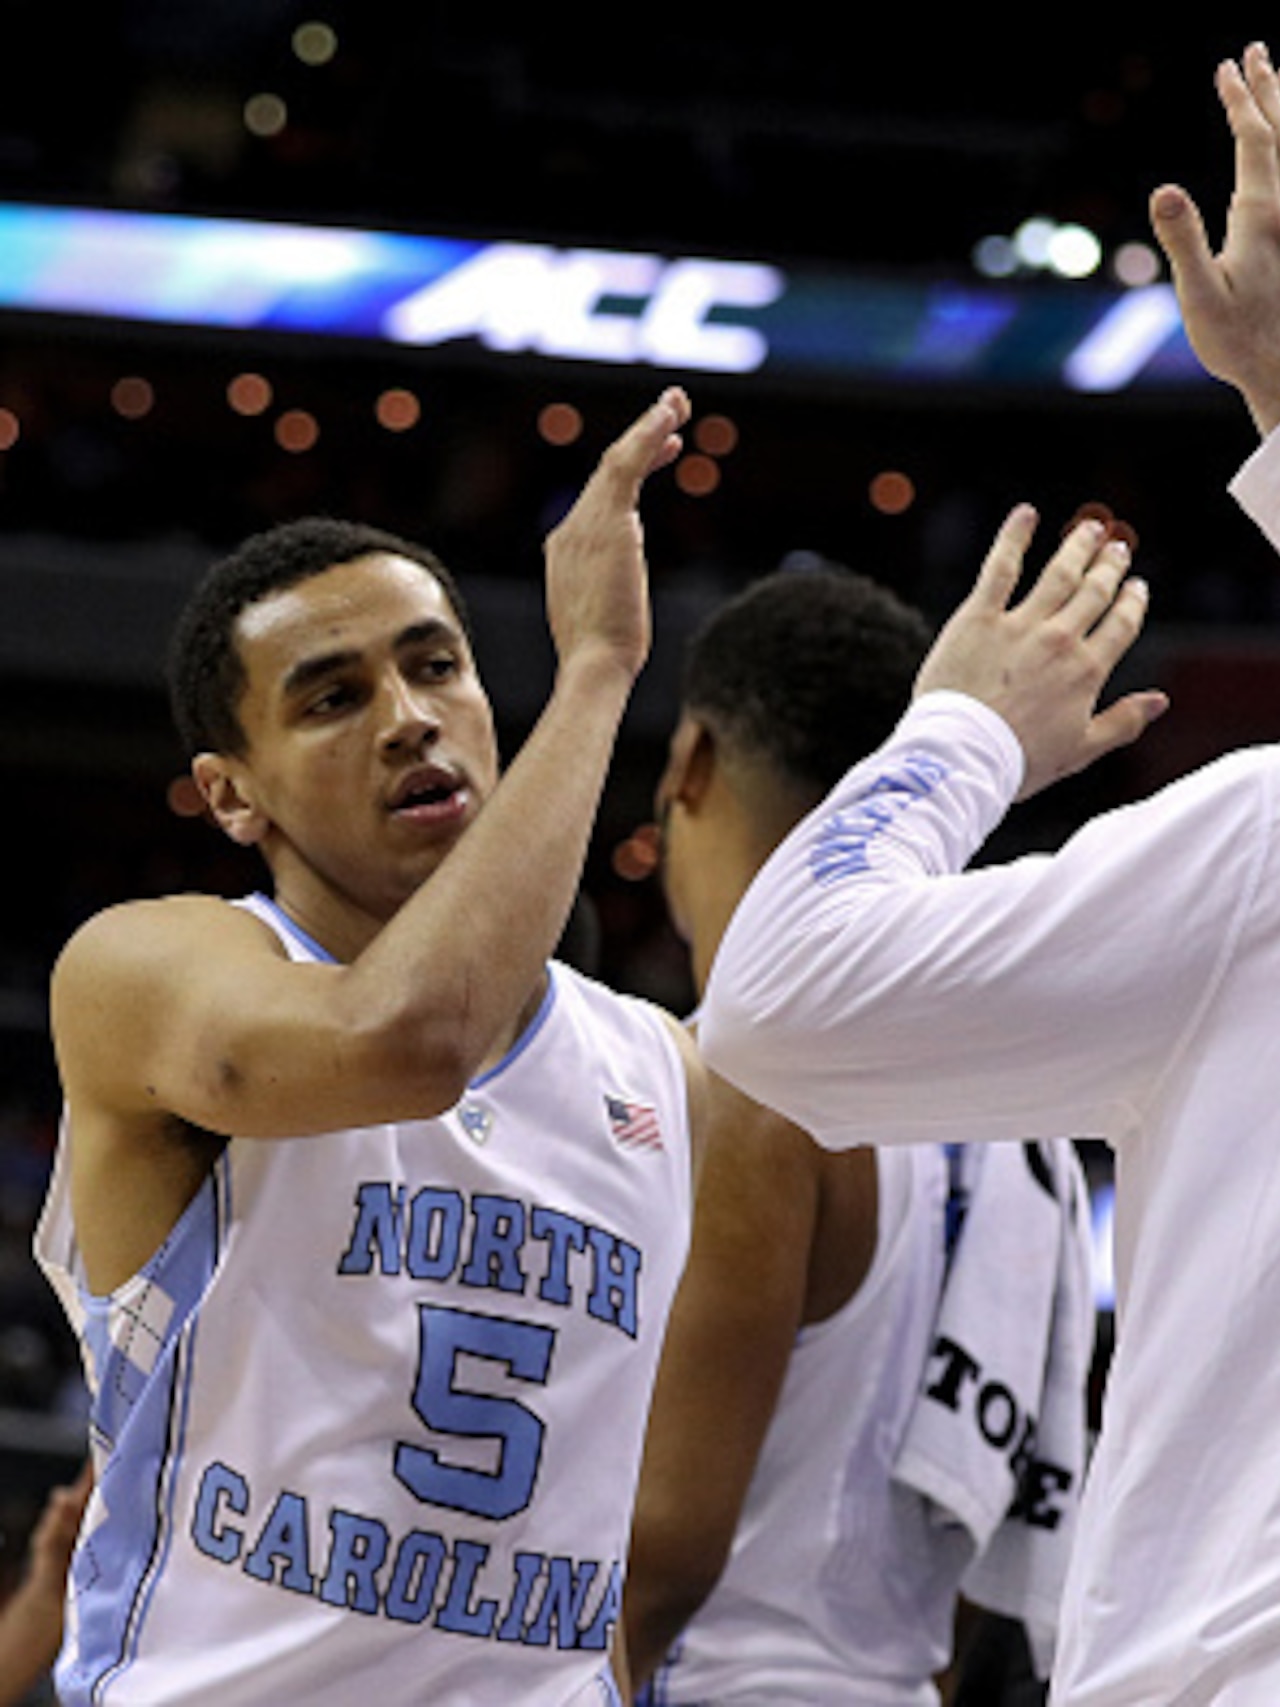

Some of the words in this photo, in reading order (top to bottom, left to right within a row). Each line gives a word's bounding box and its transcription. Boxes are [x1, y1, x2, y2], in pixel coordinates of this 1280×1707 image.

[384, 240, 784, 373] ACC
[337, 1181, 642, 1341] NORTH
[393, 1302, 557, 1522] 5
[191, 1461, 622, 1651] CAROLINA
